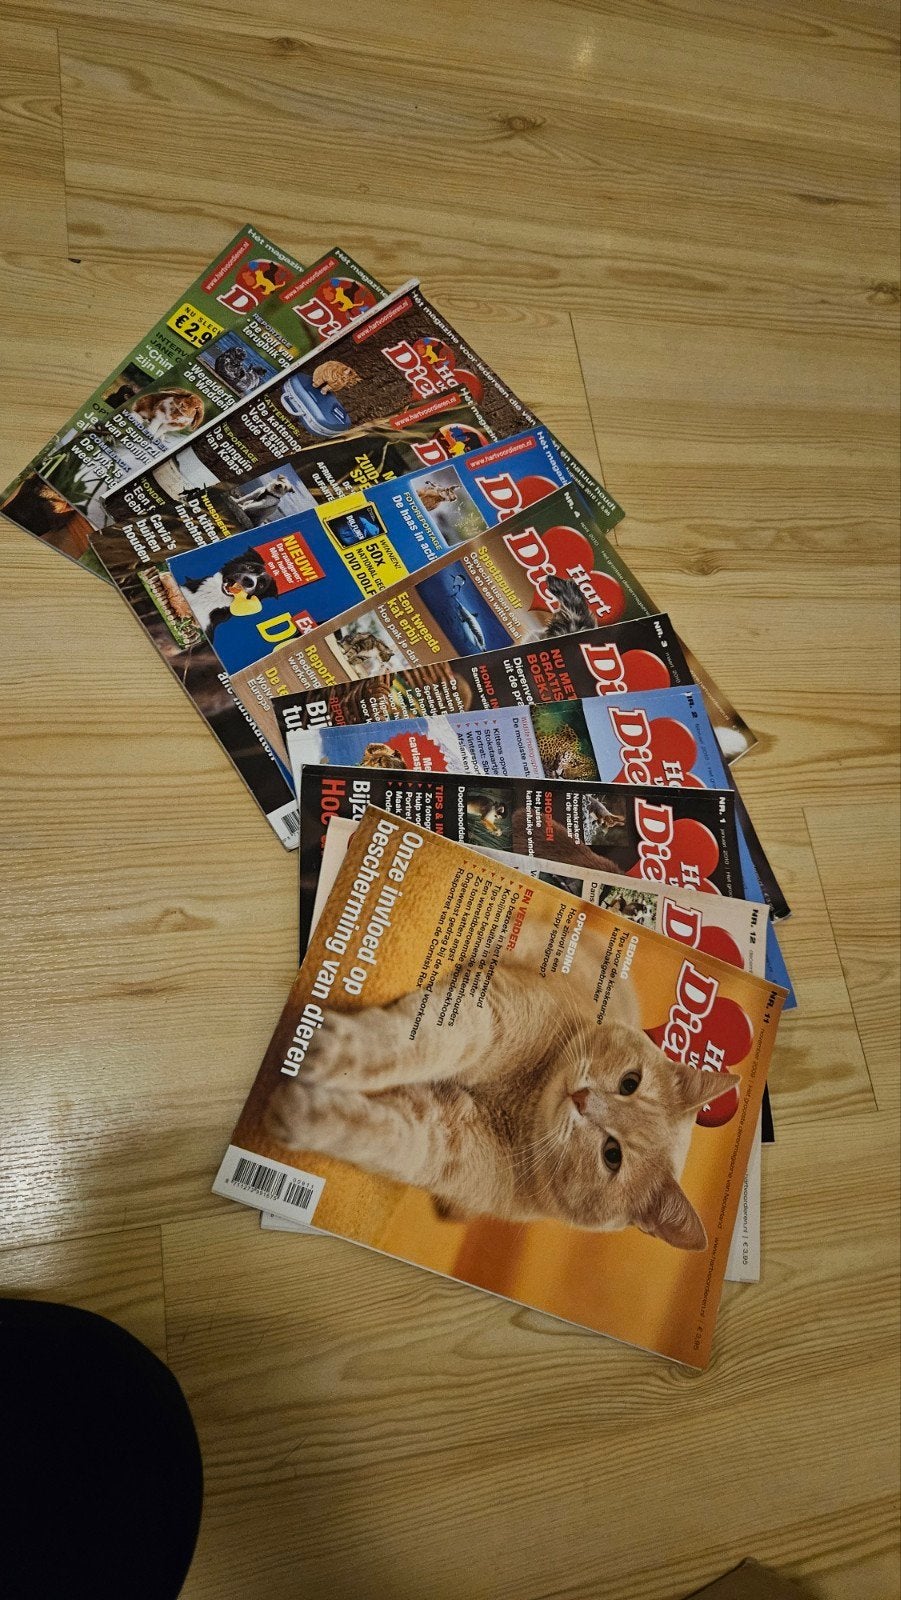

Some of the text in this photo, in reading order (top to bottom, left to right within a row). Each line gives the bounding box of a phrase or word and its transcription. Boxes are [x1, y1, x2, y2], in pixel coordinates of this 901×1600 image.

[184, 306, 196, 318] NU
[150, 339, 175, 358] JANE
[242, 326, 292, 370] terugblik op
[249, 321, 294, 362] De Golf van
[135, 354, 155, 372] zijn
[423, 306, 537, 426] magazine voor iedereen die van
[183, 370, 230, 411] de Wadden
[256, 400, 268, 417] De
[460, 387, 474, 406] Hét
[104, 421, 122, 438] van
[112, 413, 127, 428] De
[213, 426, 225, 440] De
[241, 414, 262, 436] oude
[248, 406, 291, 454] Verzorging
[71, 445, 95, 468] weer
[80, 437, 122, 478] De is
[204, 430, 244, 476] van Kaaps
[537, 431, 549, 450] Hét
[133, 486, 152, 506] Een
[563, 490, 581, 519] NR. 4
[570, 461, 617, 512] natuur houdt
[188, 498, 202, 514] De
[392, 494, 424, 542] De haas in
[403, 491, 443, 551] FOTOREPORTAGE
[122, 523, 151, 563] houden
[136, 518, 161, 552] buiten
[150, 513, 177, 550] Cavia's
[281, 534, 319, 582] NIEUW!
[344, 551, 362, 571] DVD
[356, 547, 378, 578] NATIONAL
[365, 543, 386, 567] 50x
[380, 540, 403, 571] WINNEN!
[470, 551, 522, 628] Gevecht tussen een
[478, 545, 523, 609] Spectaculair
[565, 563, 612, 618] Hart
[463, 556, 522, 639] orka en een witte haai
[377, 602, 409, 650] Hoe pak je
[387, 597, 423, 646] kat erbij
[397, 591, 441, 654] Een tweede
[653, 621, 664, 638] NR.
[265, 666, 280, 686] De
[287, 656, 312, 690] werken
[502, 658, 518, 688] uit de
[539, 651, 564, 702] GRATIS
[550, 649, 566, 669] NU
[247, 678, 271, 712] Europa
[414, 686, 422, 697] de
[431, 682, 445, 709] Animal
[440, 680, 454, 712] minuten
[449, 679, 457, 690] De
[470, 666, 484, 694] Samen
[479, 665, 496, 696] HOND
[456, 731, 471, 771] Afslanken
[475, 729, 487, 759] Portret:
[483, 728, 500, 775] Stokstaartje
[492, 727, 504, 754] Kittens
[512, 717, 527, 760] De mooiste
[395, 790, 404, 814] Maak
[405, 791, 414, 821] Portret
[415, 792, 423, 812] Hulp
[424, 792, 433, 804] Zo
[435, 785, 445, 820] TIPS &
[525, 789, 534, 836] kattenluikje
[533, 790, 543, 828] Het juiste
[544, 791, 555, 842] SHOPPEN
[565, 792, 573, 839] in de natuur
[718, 796, 726, 815] NR.
[571, 792, 581, 846] Notenkrakers
[342, 830, 425, 996] Onze invloed op
[415, 866, 464, 989] Rasportret van de Cornish Rex
[446, 875, 482, 962] Zo tonen katten angst
[505, 888, 534, 952] EN VERDER:
[750, 908, 760, 928] NR.
[280, 818, 400, 1078] bescherming van dieren
[409, 871, 473, 1041] Ongewenst gedrag bij de hond voorkomen
[434, 879, 492, 1027] Een wereldberoemde grondeekhoorn
[447, 883, 501, 1028] Tips voor beginnende rattenhouders
[468, 887, 511, 998] Konijnen buiten in de winter
[475, 891, 520, 1008] Op bezoek in het Kattenwoud
[537, 903, 567, 978] puppy speelgroep?
[550, 907, 577, 973] Hoe zinvol is een
[560, 911, 587, 974] OPVOEDING
[749, 931, 758, 945] 12
[592, 927, 620, 1003] kattenbakgebruiker
[619, 934, 639, 980] GEDRAG
[595, 931, 629, 1025] Tips voor de kieskeurige
[762, 1012, 772, 1025] 11
[765, 990, 779, 1010] NR.
